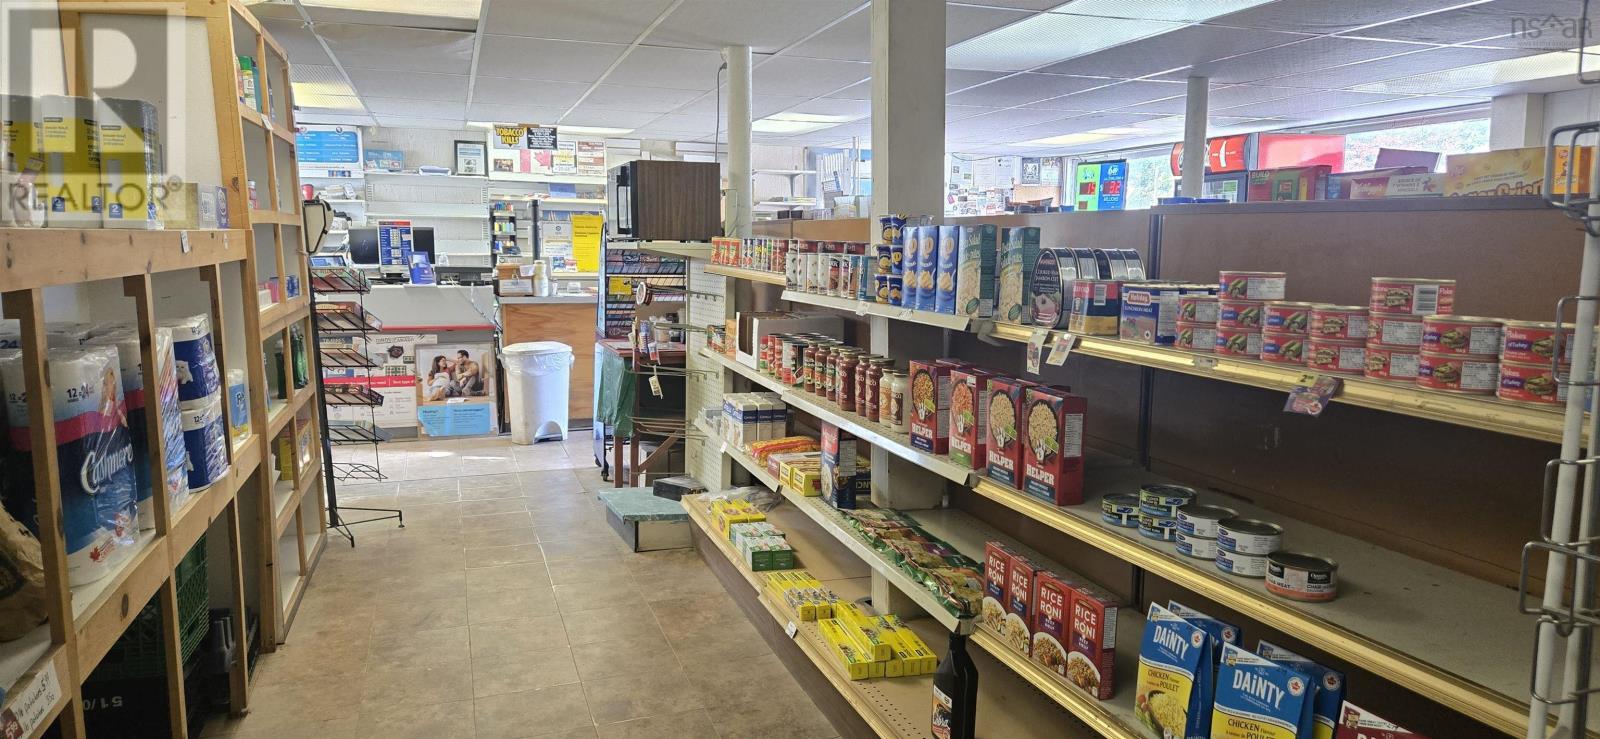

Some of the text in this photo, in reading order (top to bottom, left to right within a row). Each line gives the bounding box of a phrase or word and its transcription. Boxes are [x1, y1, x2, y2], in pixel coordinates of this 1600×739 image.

[496, 126, 524, 137] TOBACCO
[501, 136, 519, 145] KILLS
[111, 204, 119, 213] 2
[911, 422, 933, 439] HELPER
[951, 435, 972, 454] HELPER
[989, 450, 1014, 471] HELPER
[1026, 463, 1055, 486] HELPER
[988, 556, 1005, 574] RICE
[987, 568, 1004, 585] RONI
[1012, 569, 1029, 590] RICE
[1011, 584, 1027, 602] RONI
[1040, 586, 1063, 606] RICE
[1040, 601, 1062, 620] RONI
[1075, 604, 1096, 625] RICE
[1074, 619, 1096, 640] RONI
[1147, 670, 1169, 680] CHICKEN
[1159, 680, 1181, 693] POULET
[1227, 719, 1260, 731] CHICKEN
